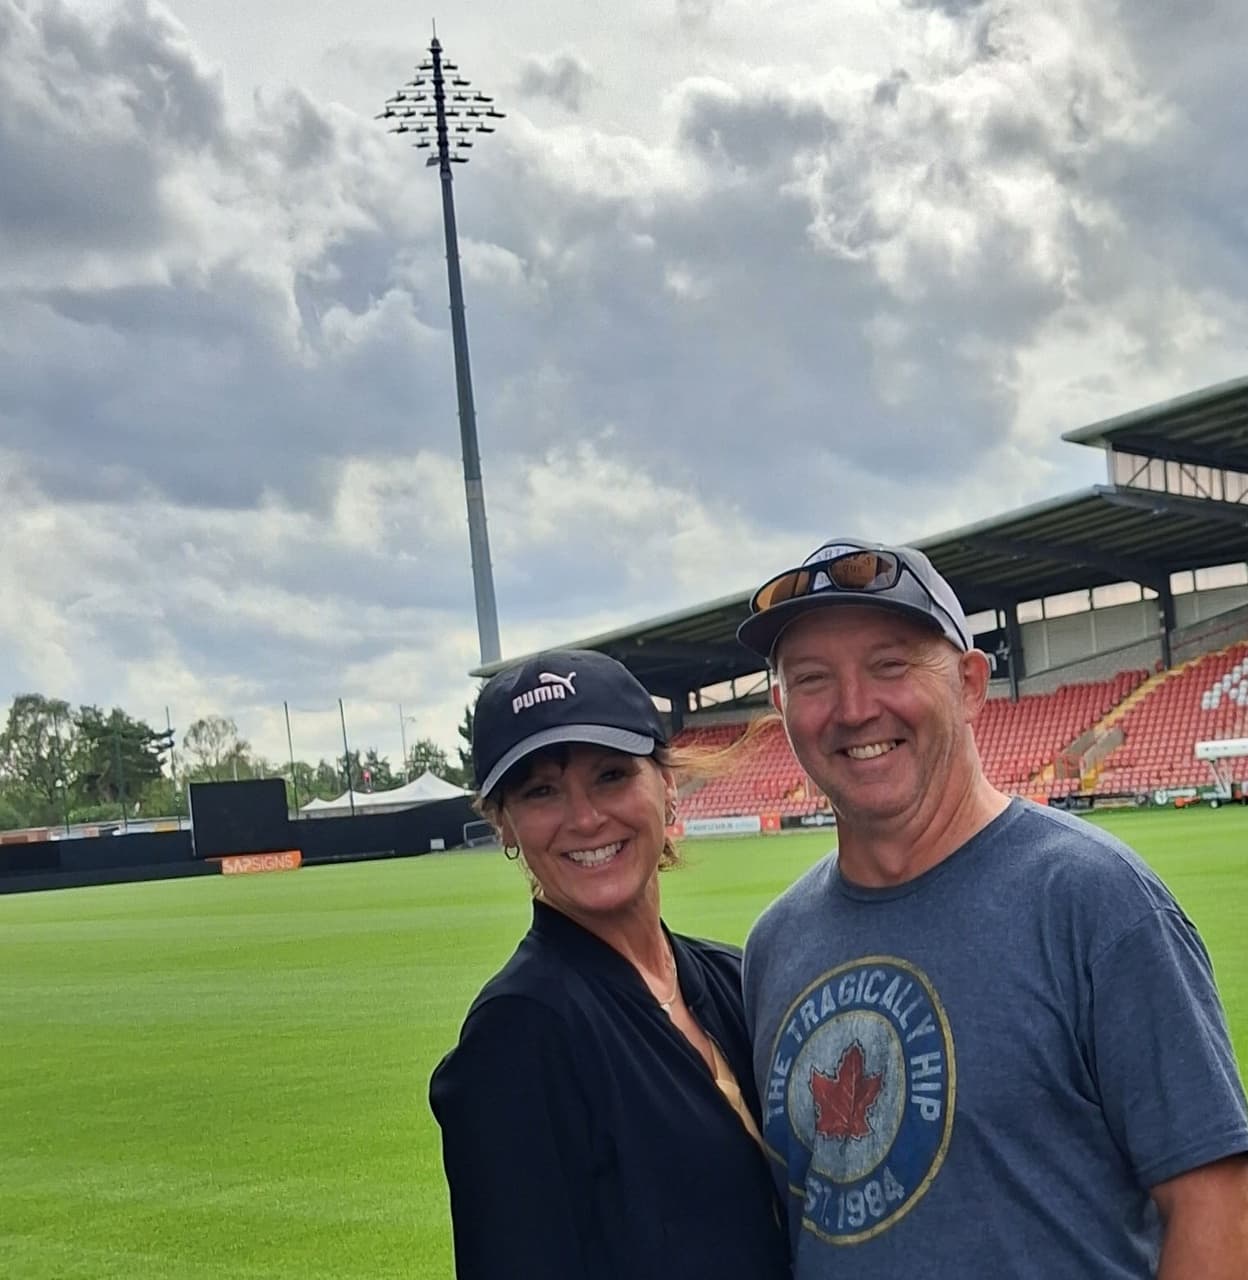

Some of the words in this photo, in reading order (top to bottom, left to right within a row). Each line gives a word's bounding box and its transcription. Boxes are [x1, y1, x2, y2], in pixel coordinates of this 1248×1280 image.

[512, 684, 566, 714] PUMA
[786, 969, 936, 1044] TRAGICALLY
[909, 1051, 942, 1121] HIP
[837, 1165, 905, 1229] 1984
